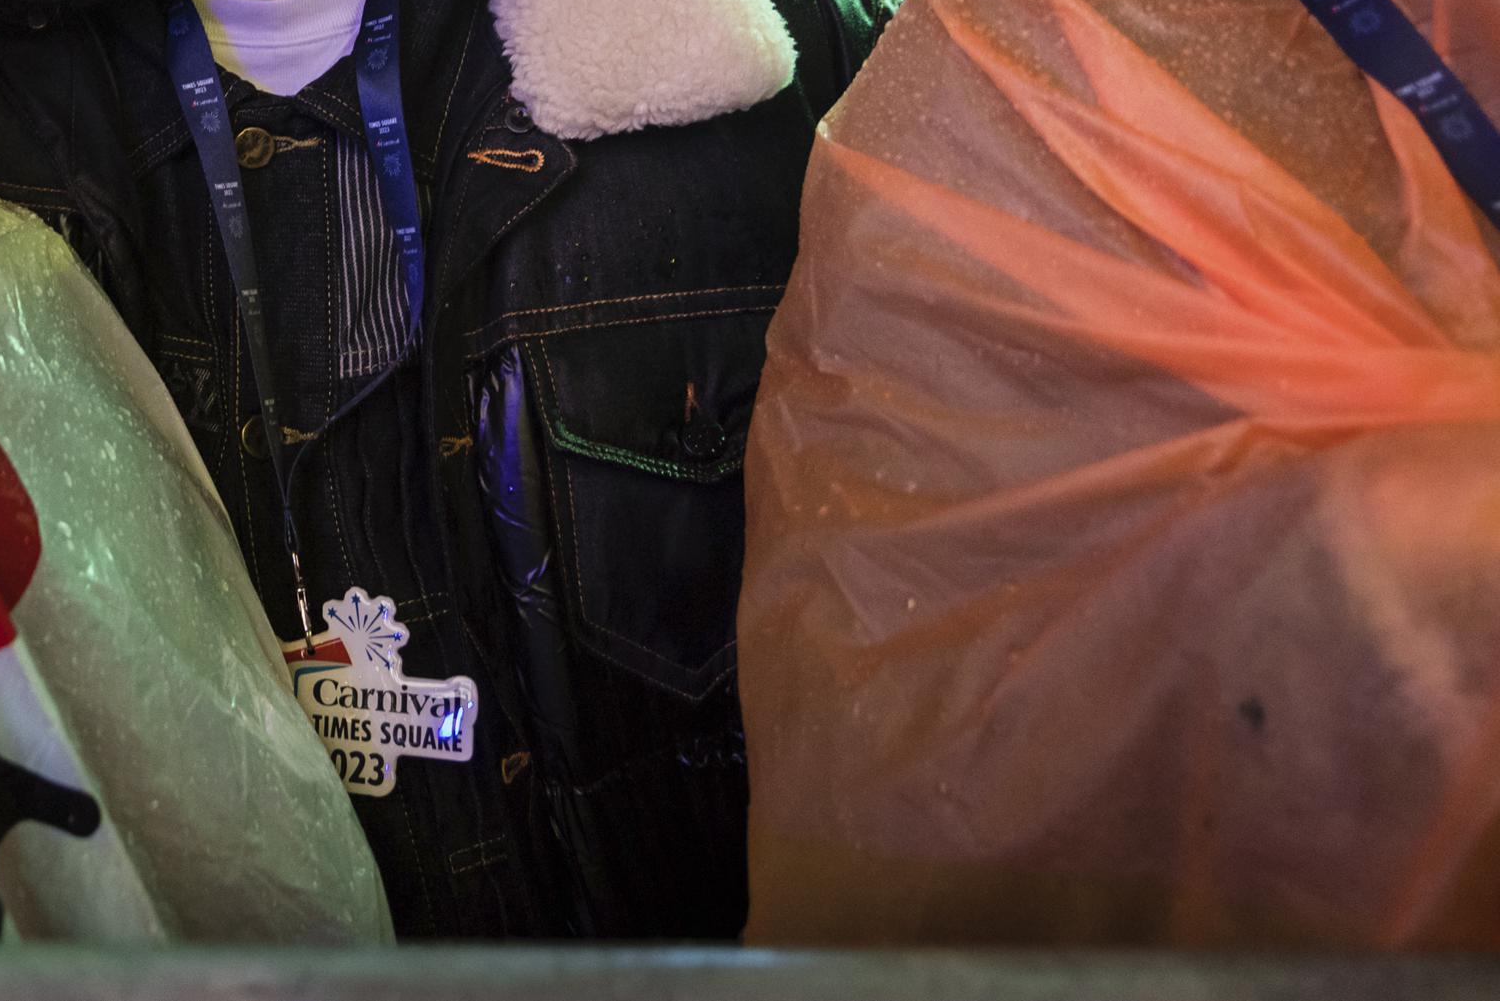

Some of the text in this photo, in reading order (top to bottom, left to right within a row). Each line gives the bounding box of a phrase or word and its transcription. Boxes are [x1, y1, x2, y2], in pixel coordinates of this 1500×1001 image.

[312, 678, 461, 719] Carnival
[312, 713, 463, 753] TIMES SQUARE
[331, 748, 385, 786] 023
